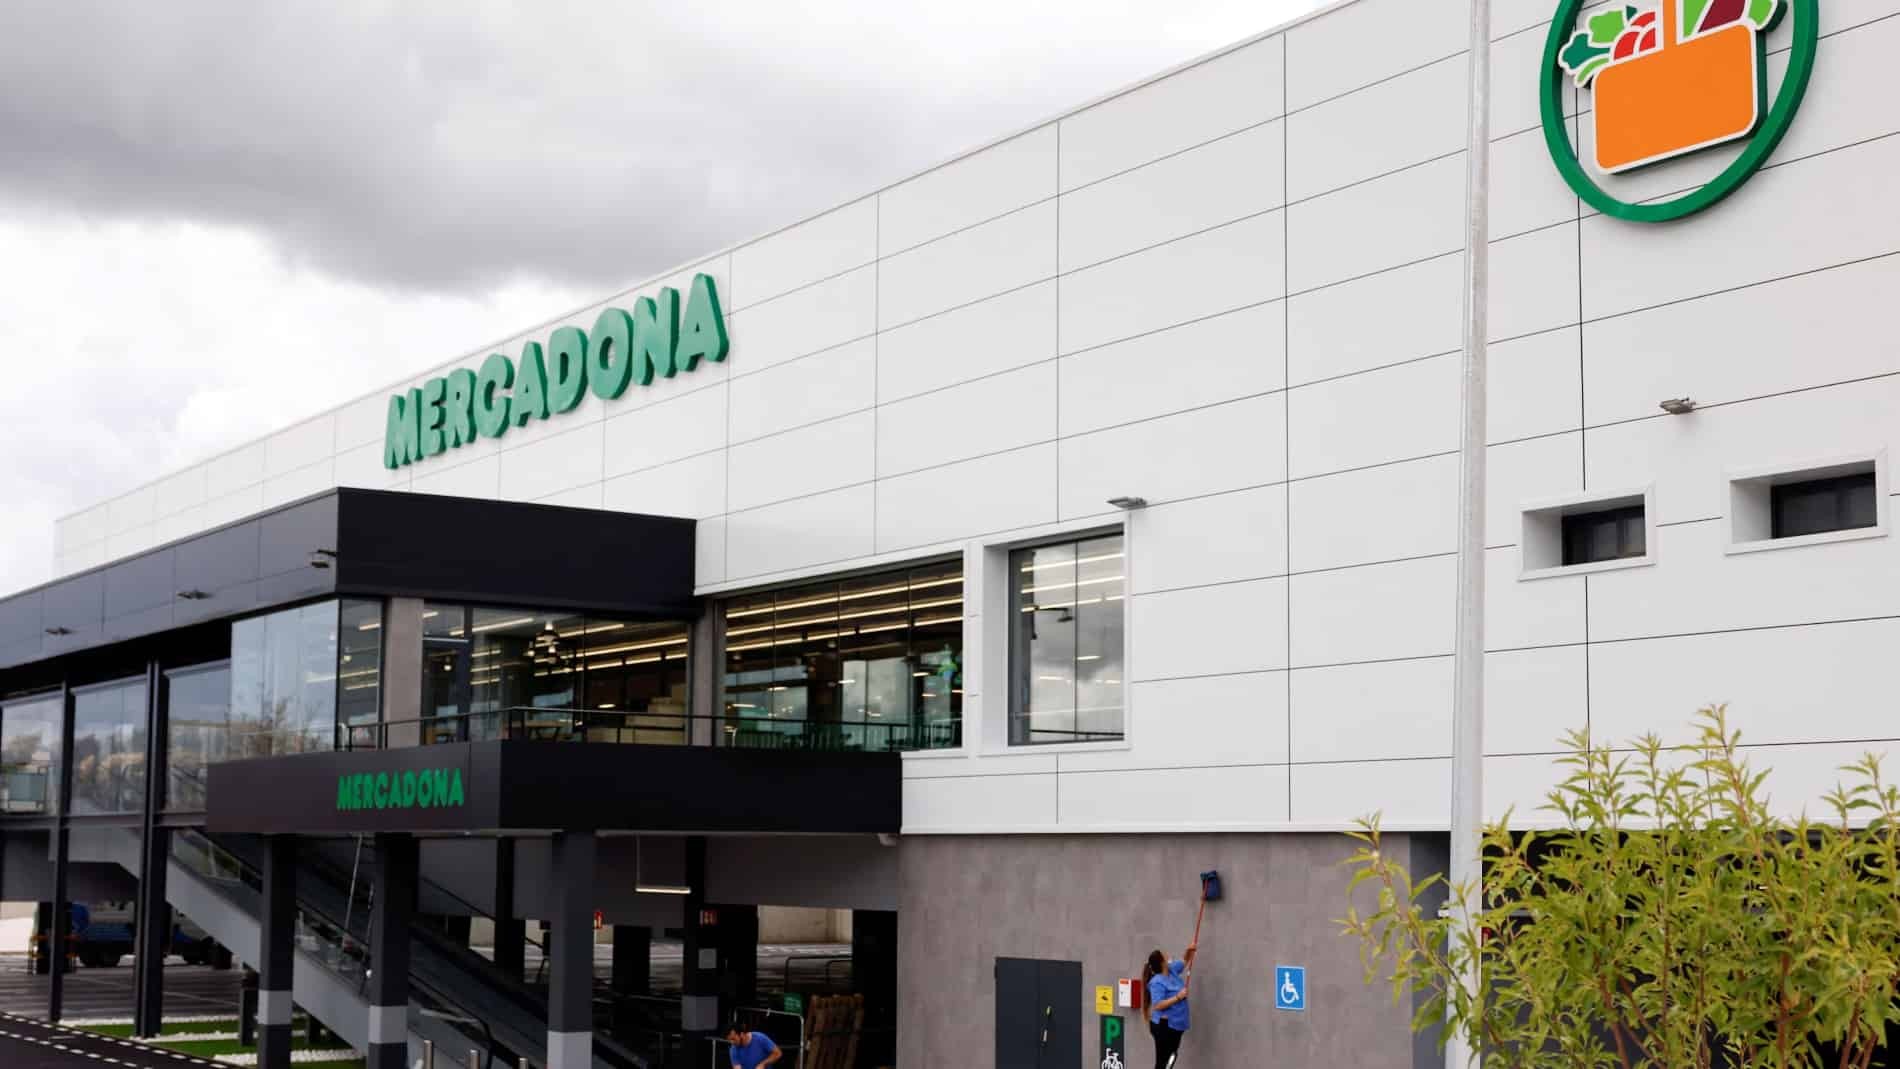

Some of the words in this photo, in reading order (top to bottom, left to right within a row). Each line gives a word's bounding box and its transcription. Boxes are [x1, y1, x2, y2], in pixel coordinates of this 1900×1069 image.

[384, 272, 730, 470] MERCADONA
[337, 768, 464, 810] MERCADONA
[1105, 1017, 1121, 1045] P
